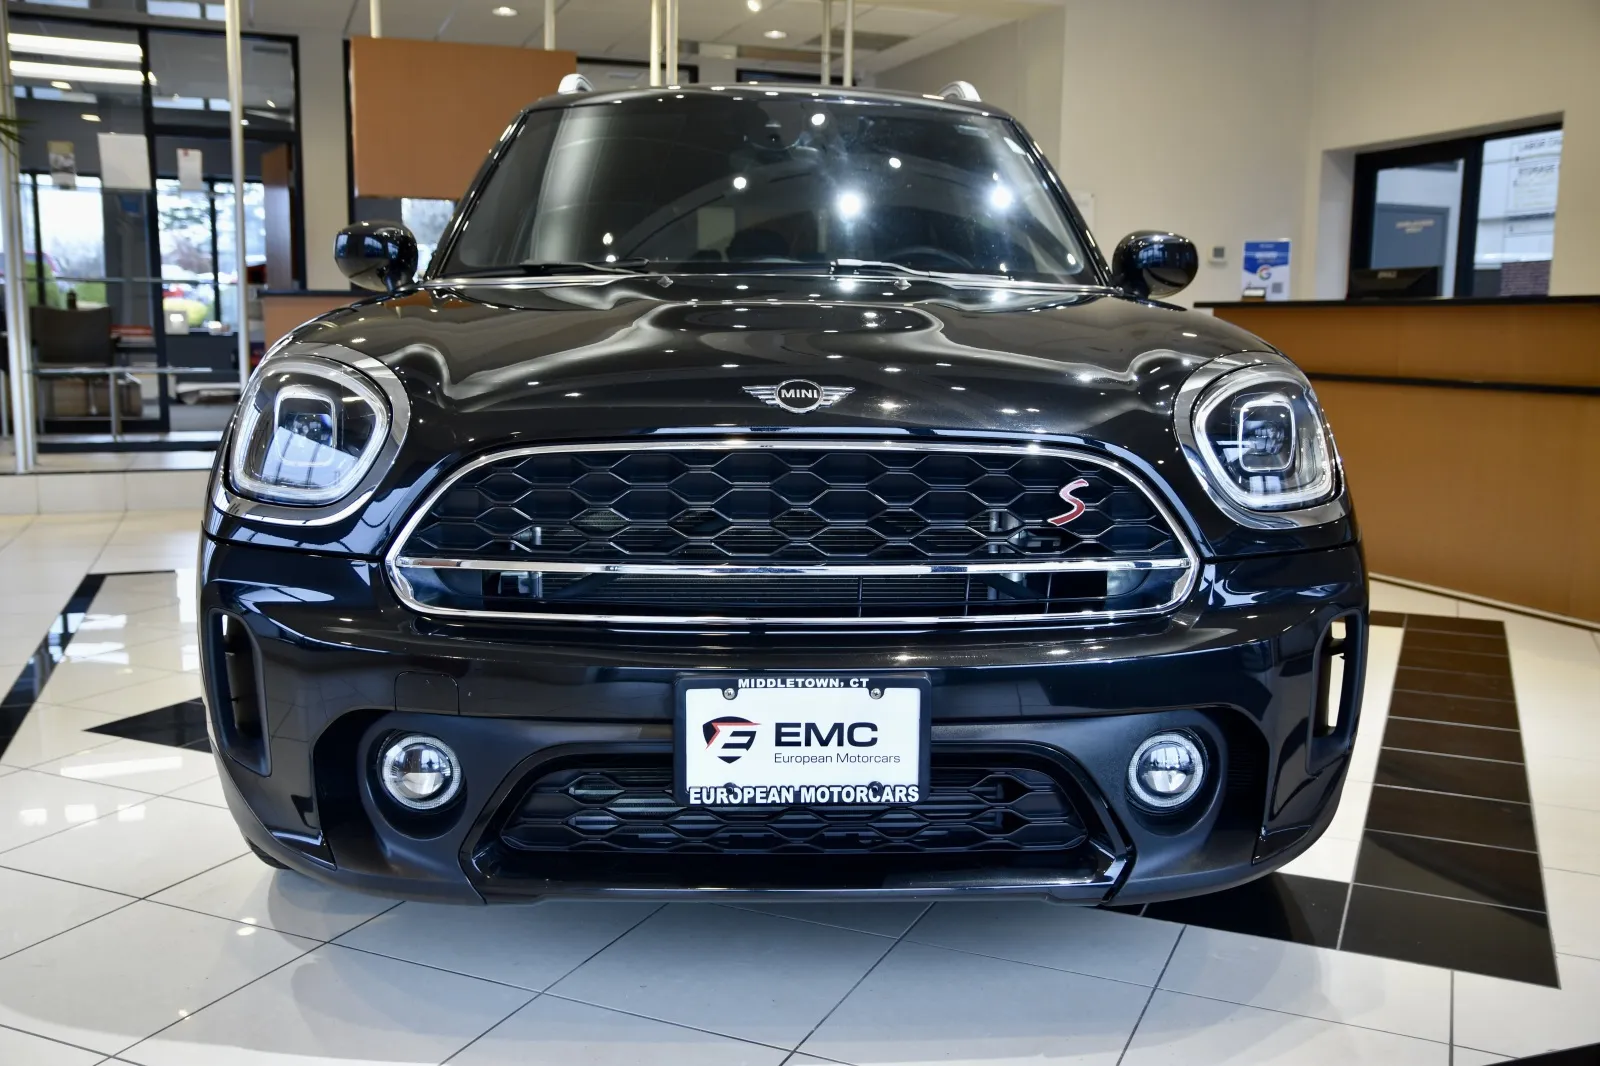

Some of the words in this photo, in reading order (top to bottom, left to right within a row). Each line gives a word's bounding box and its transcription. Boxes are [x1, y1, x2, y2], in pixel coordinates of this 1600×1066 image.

[780, 389, 818, 399] MINI
[1047, 478, 1089, 527] S
[737, 678, 845, 688] MIDDLETOWN,
[849, 678, 870, 688] CT
[774, 722, 879, 747] EMC
[774, 753, 833, 765] European
[836, 753, 901, 764] Motorcars
[689, 786, 794, 804] EUROPEAN
[801, 785, 920, 803] MOTORCARS
